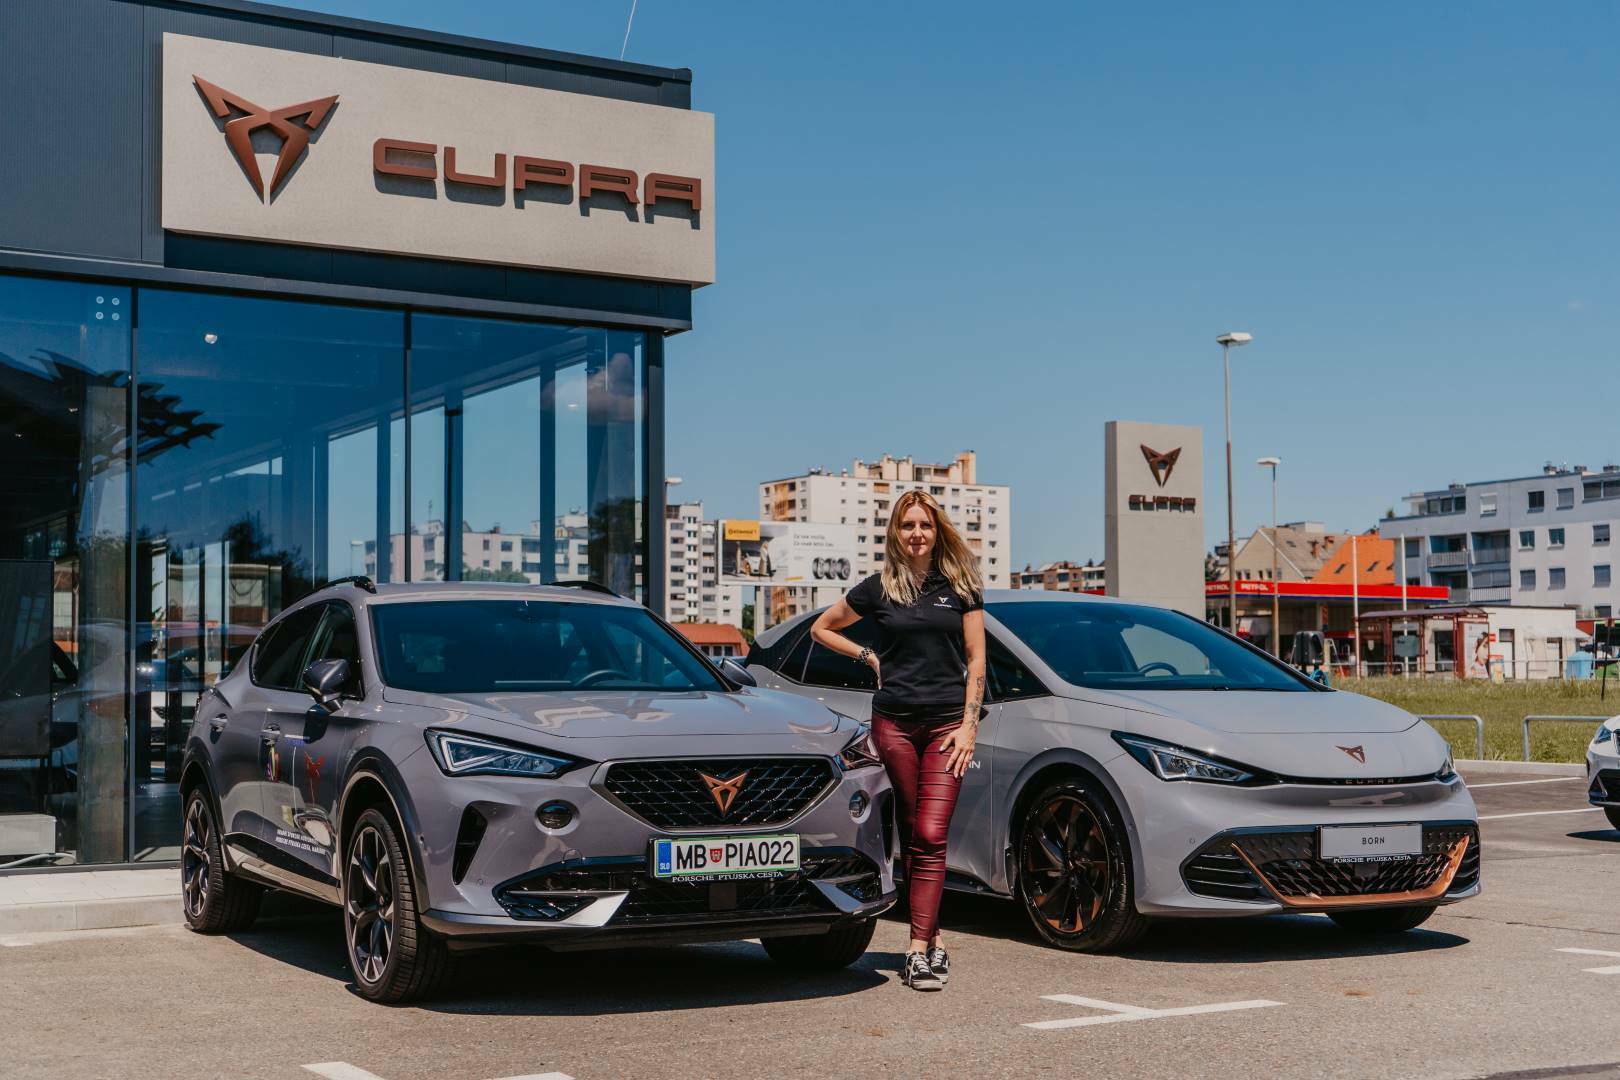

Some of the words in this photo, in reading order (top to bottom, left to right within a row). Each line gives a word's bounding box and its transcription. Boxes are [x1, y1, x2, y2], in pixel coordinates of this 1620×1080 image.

[373, 137, 702, 213] CUPRA
[1128, 494, 1196, 509] CUPRA
[1240, 583, 1269, 591] PETROL
[1361, 836, 1385, 845] BORN
[676, 844, 708, 870] MB
[725, 840, 795, 868] PIA022
[1333, 856, 1364, 864] PORSCHE
[659, 862, 671, 870] SLO
[672, 875, 715, 883] PORSCHE
[718, 873, 755, 881] PTUJSKA
